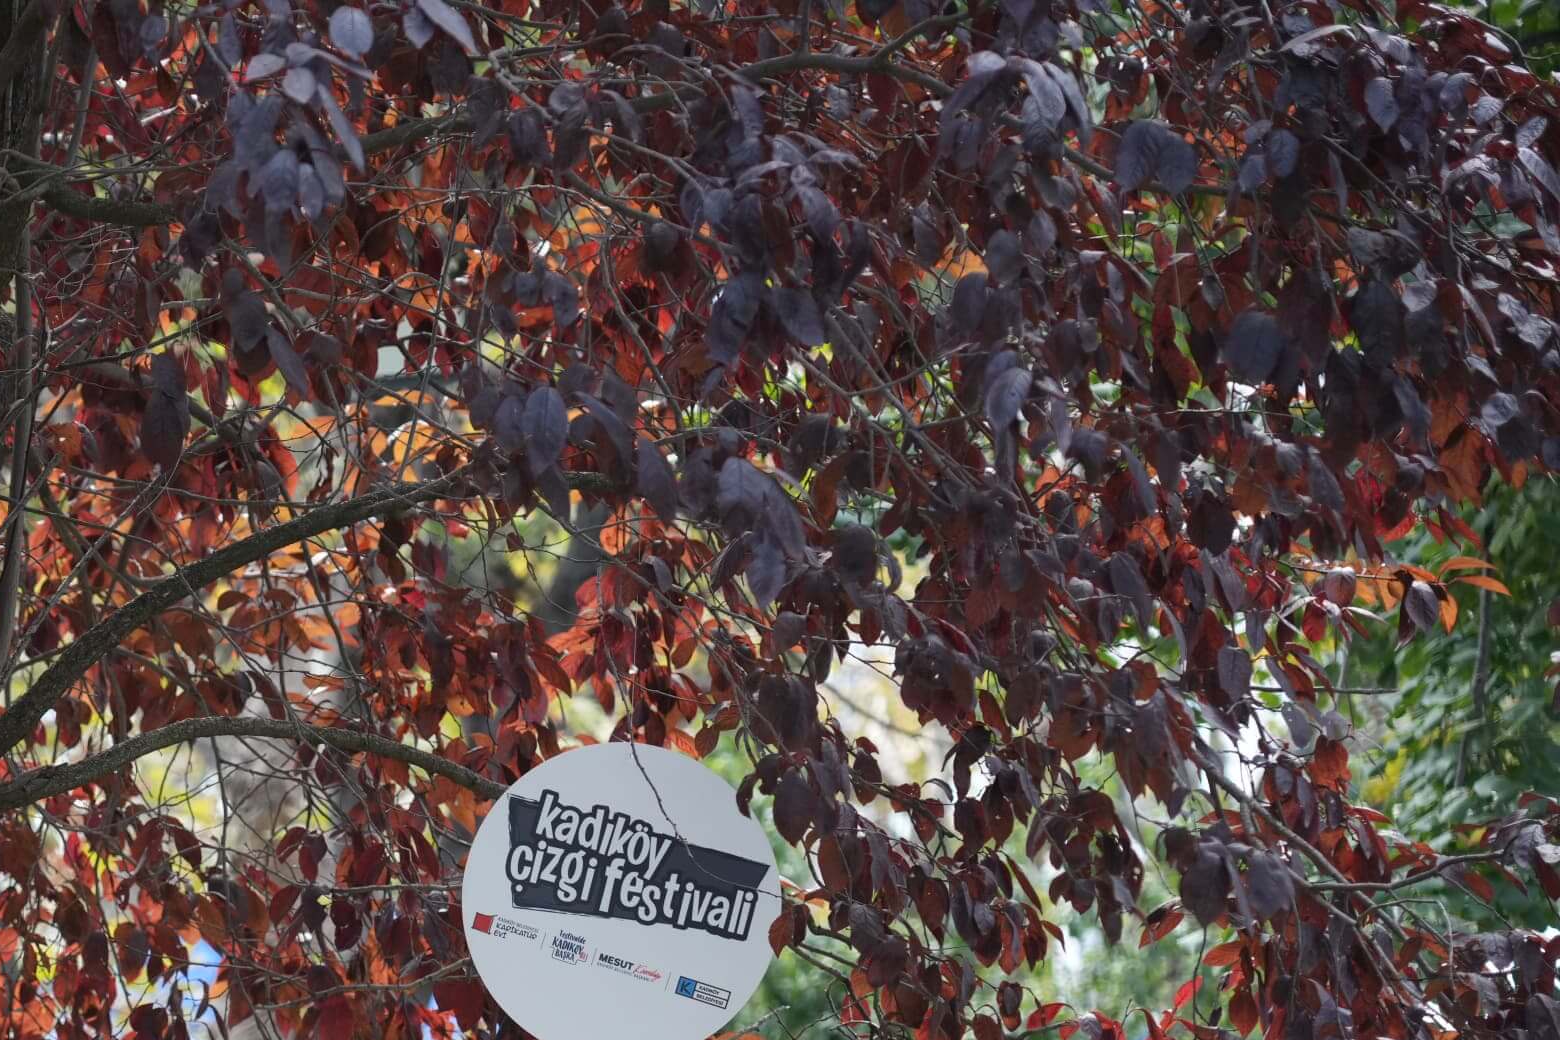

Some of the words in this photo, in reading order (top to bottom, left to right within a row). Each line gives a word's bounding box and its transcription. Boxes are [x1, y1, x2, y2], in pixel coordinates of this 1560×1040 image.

[535, 793, 672, 880] kadıköy
[509, 840, 597, 902] çizgi
[598, 858, 754, 935] festivali
[598, 953, 634, 971] MESUT
